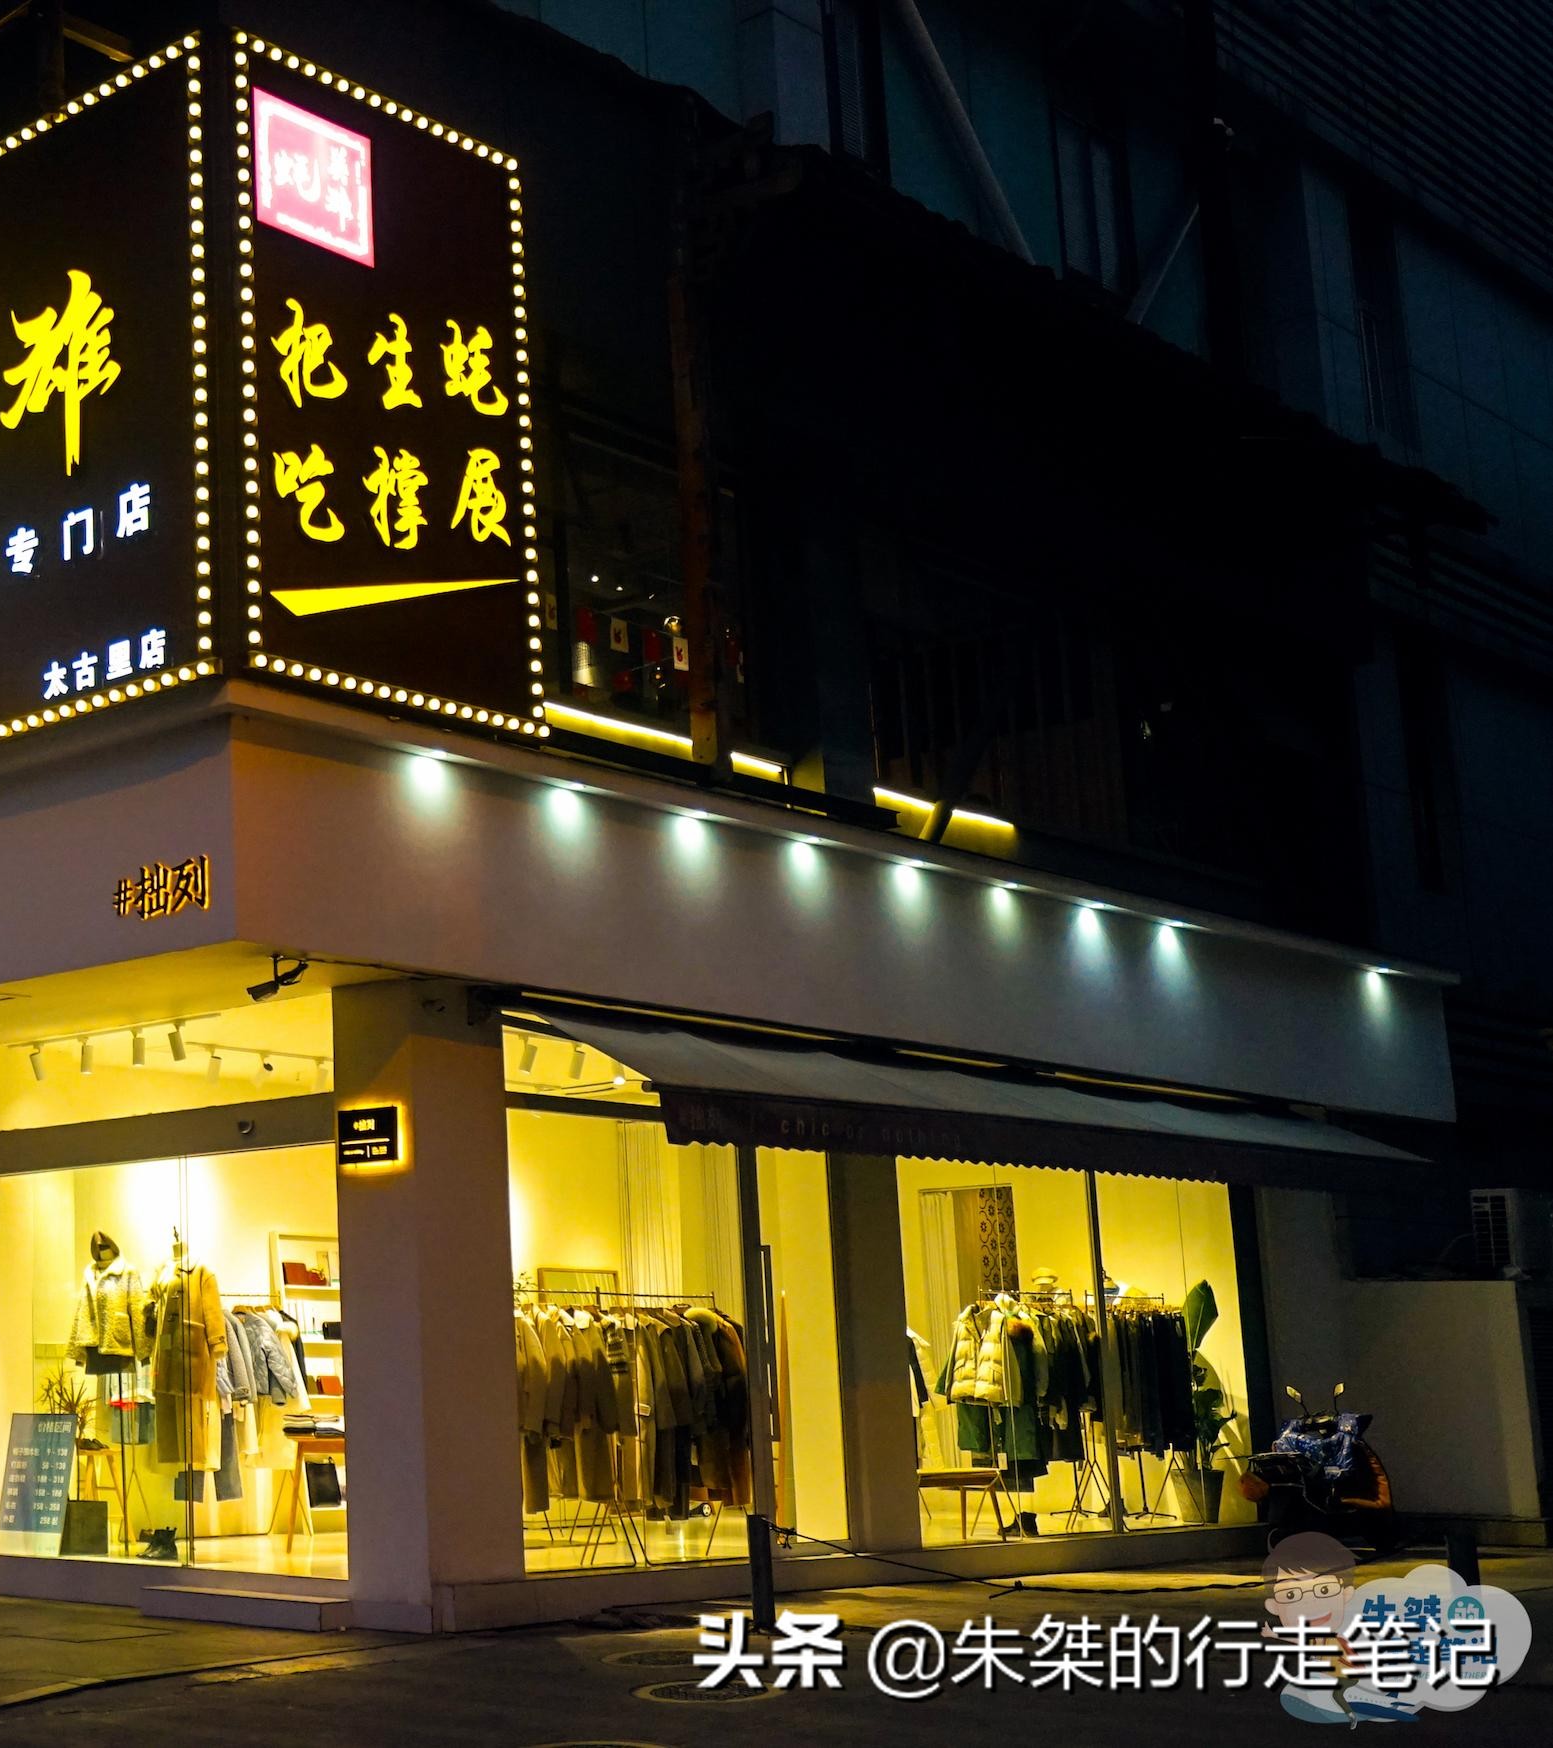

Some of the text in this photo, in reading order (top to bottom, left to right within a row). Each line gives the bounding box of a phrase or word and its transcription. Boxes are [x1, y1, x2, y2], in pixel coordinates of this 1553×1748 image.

[270, 298, 509, 416] 把生蚝
[43, 628, 167, 700] 太古里店
